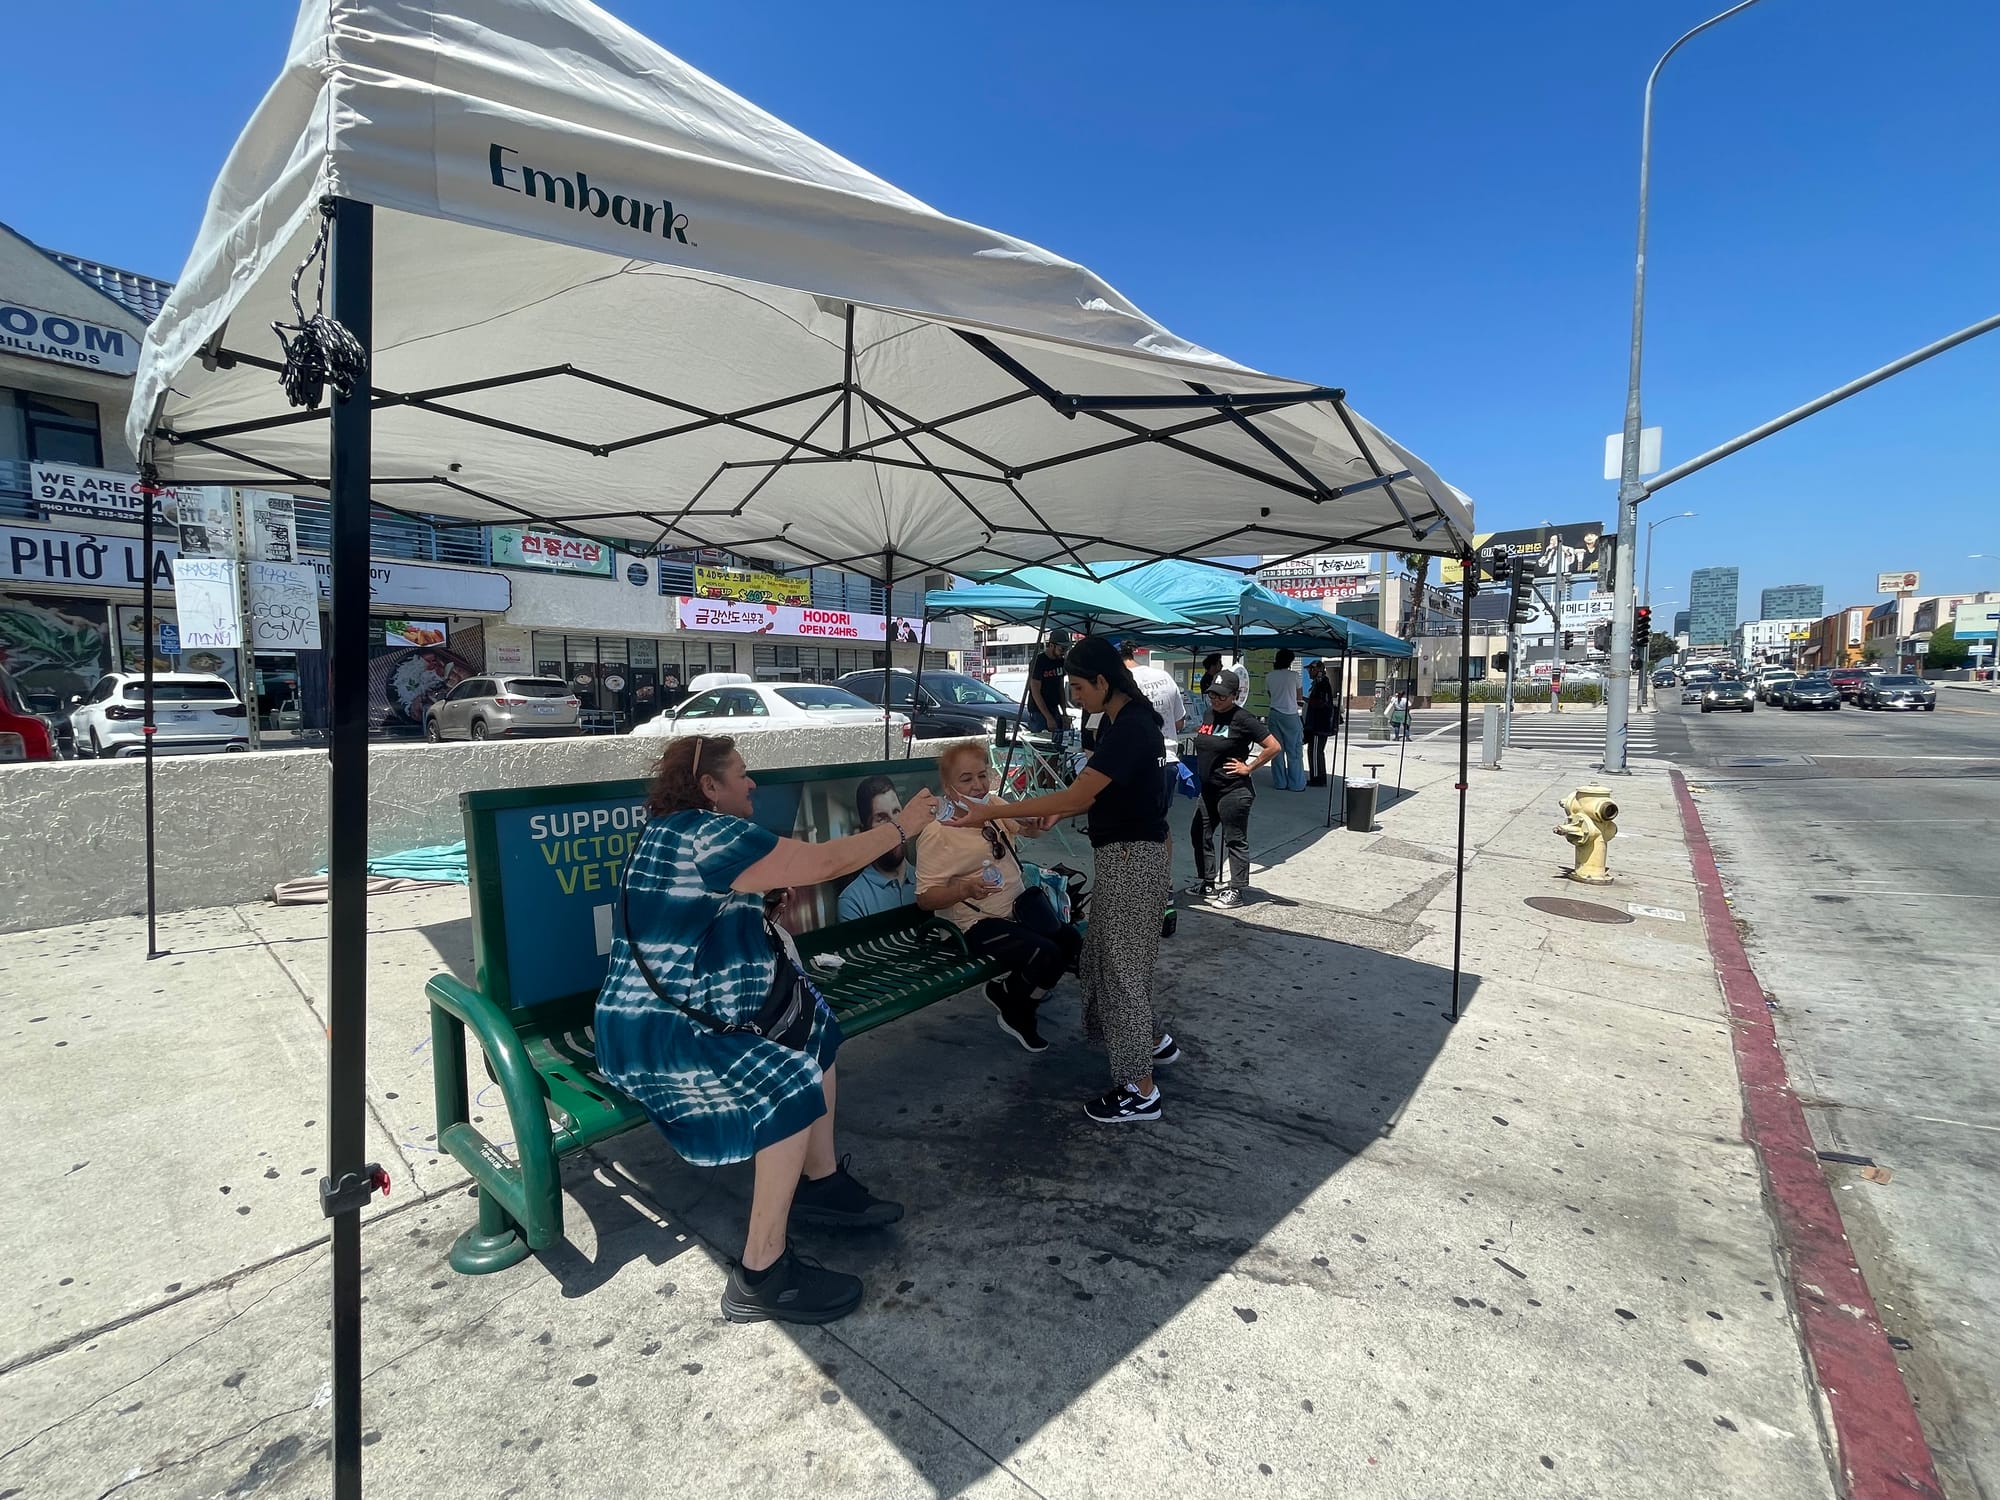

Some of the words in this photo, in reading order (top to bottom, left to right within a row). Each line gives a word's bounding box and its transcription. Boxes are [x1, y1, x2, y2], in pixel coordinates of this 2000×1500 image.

[489, 142, 689, 245] Embark
[38, 471, 76, 487] WE
[83, 478, 126, 494] ARE
[39, 503, 63, 512] PHO
[65, 505, 93, 515] LALA
[803, 610, 850, 625] HODORI
[799, 624, 826, 637] OPEN
[828, 626, 858, 638] 24HRS
[530, 805, 648, 840] SUPPOR
[555, 859, 623, 895] VET
